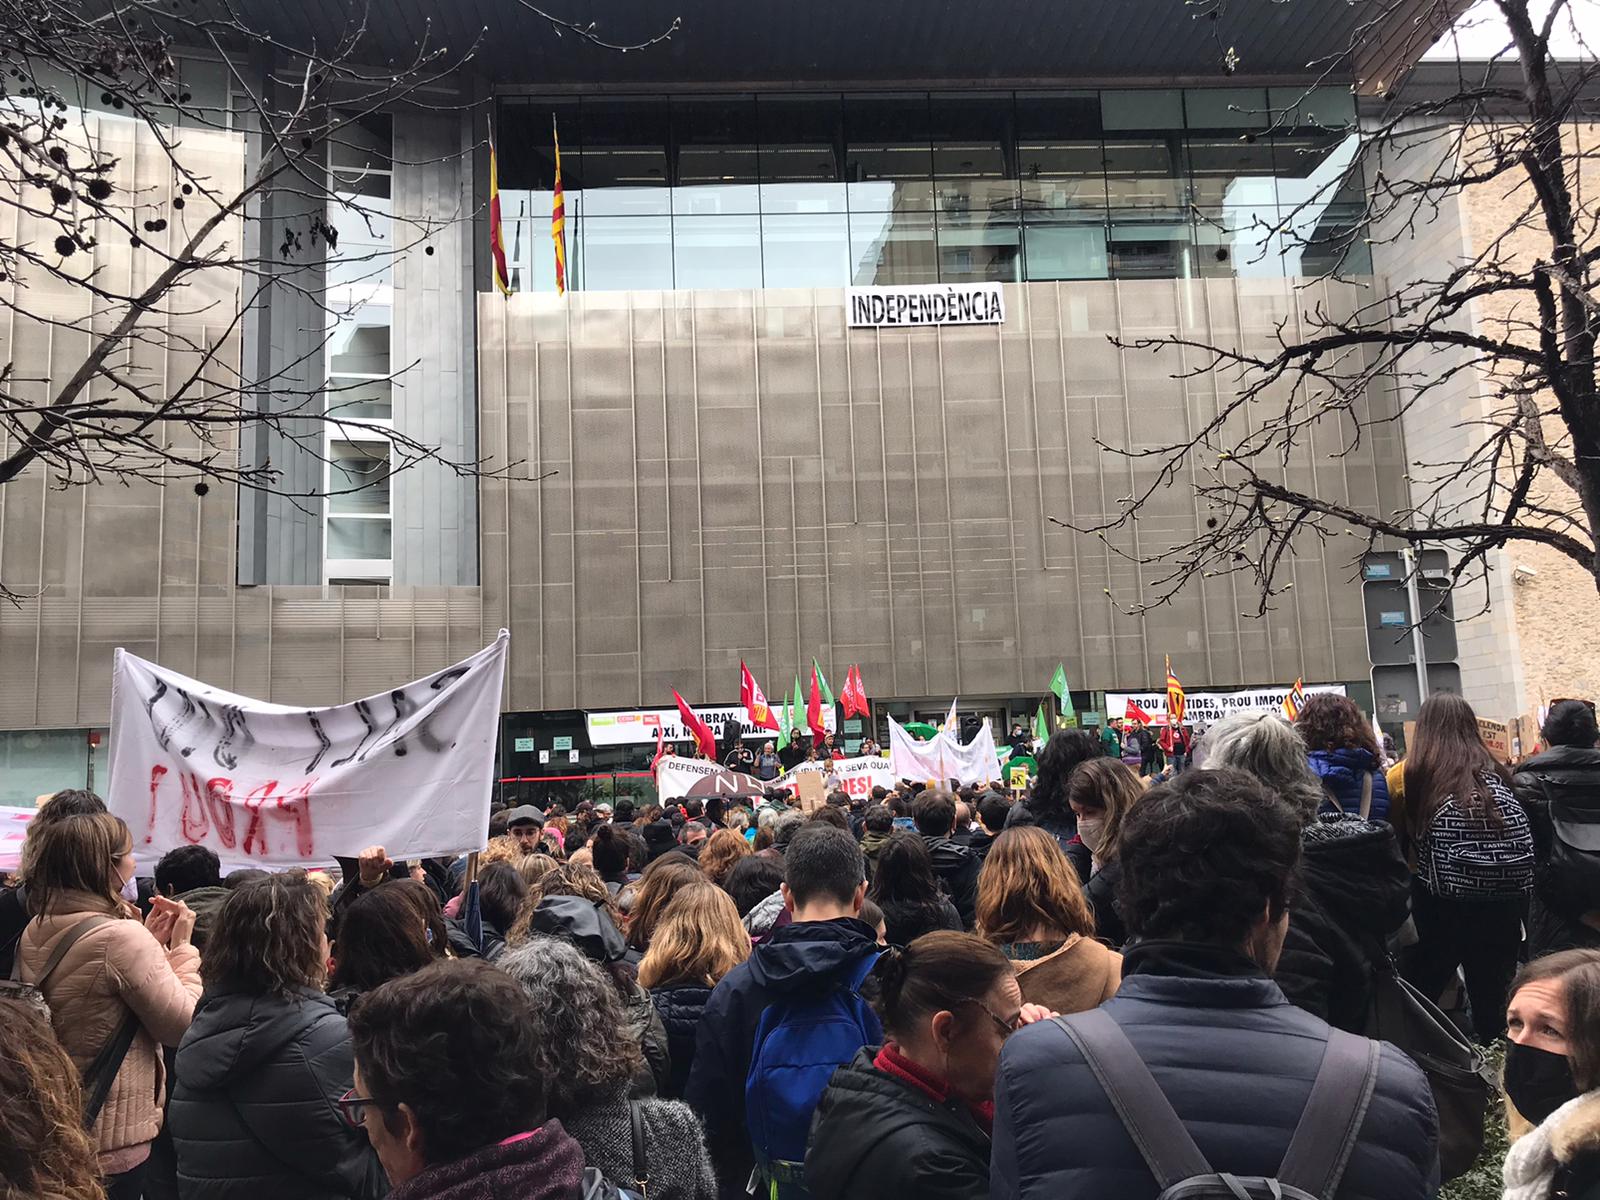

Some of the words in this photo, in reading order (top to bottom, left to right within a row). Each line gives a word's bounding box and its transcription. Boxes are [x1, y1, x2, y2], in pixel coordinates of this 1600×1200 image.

[852, 287, 1002, 324] INDEPENDÈNCIA
[1131, 698, 1158, 709] ROU
[1222, 696, 1251, 707] PROU
[1184, 710, 1226, 721] AMBRAY
[845, 762, 868, 772] SEVA
